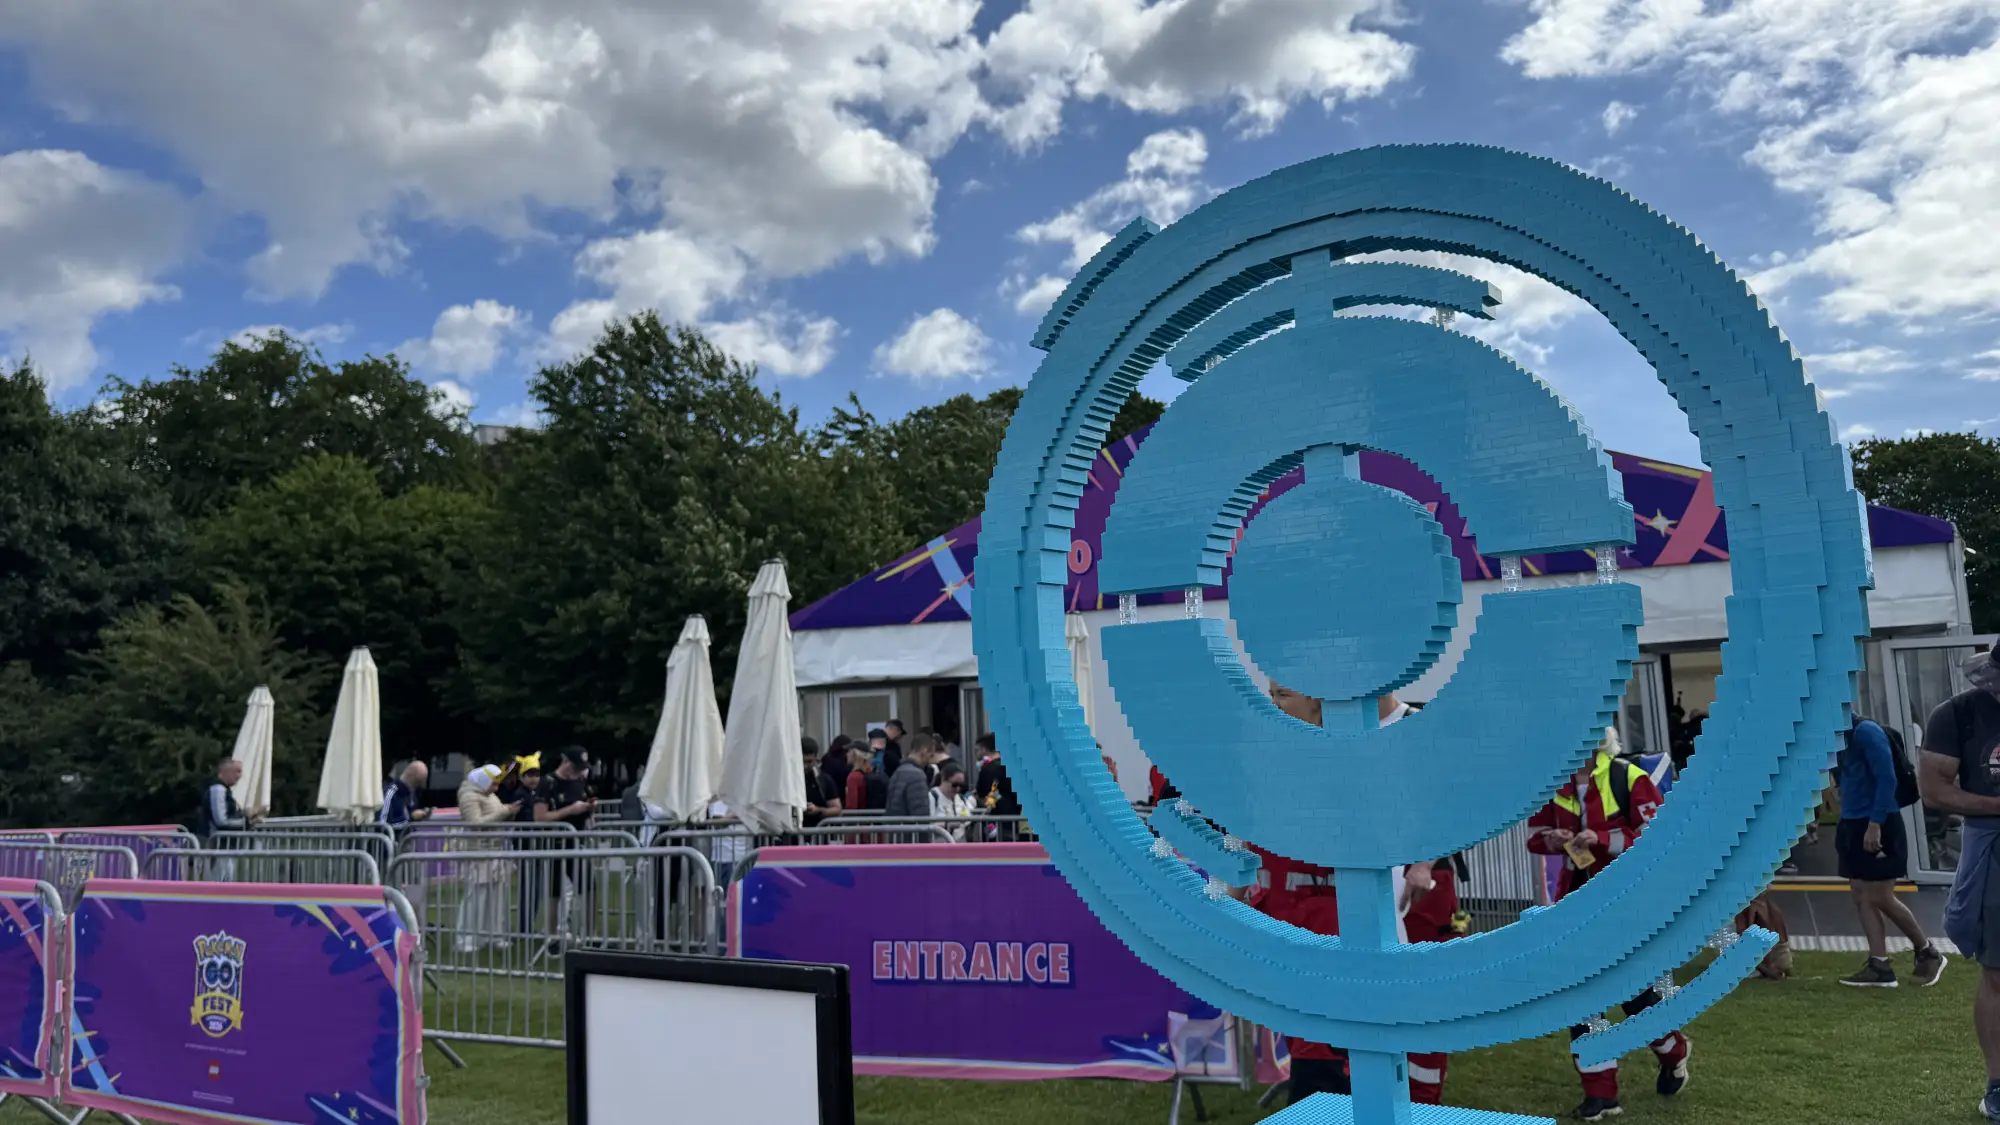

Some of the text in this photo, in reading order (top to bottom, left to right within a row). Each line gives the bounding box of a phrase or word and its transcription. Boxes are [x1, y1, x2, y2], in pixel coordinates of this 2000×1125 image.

[203, 959, 235, 989] GO
[872, 940, 1070, 984] ENTRANCE
[202, 996, 233, 1014] FEST
